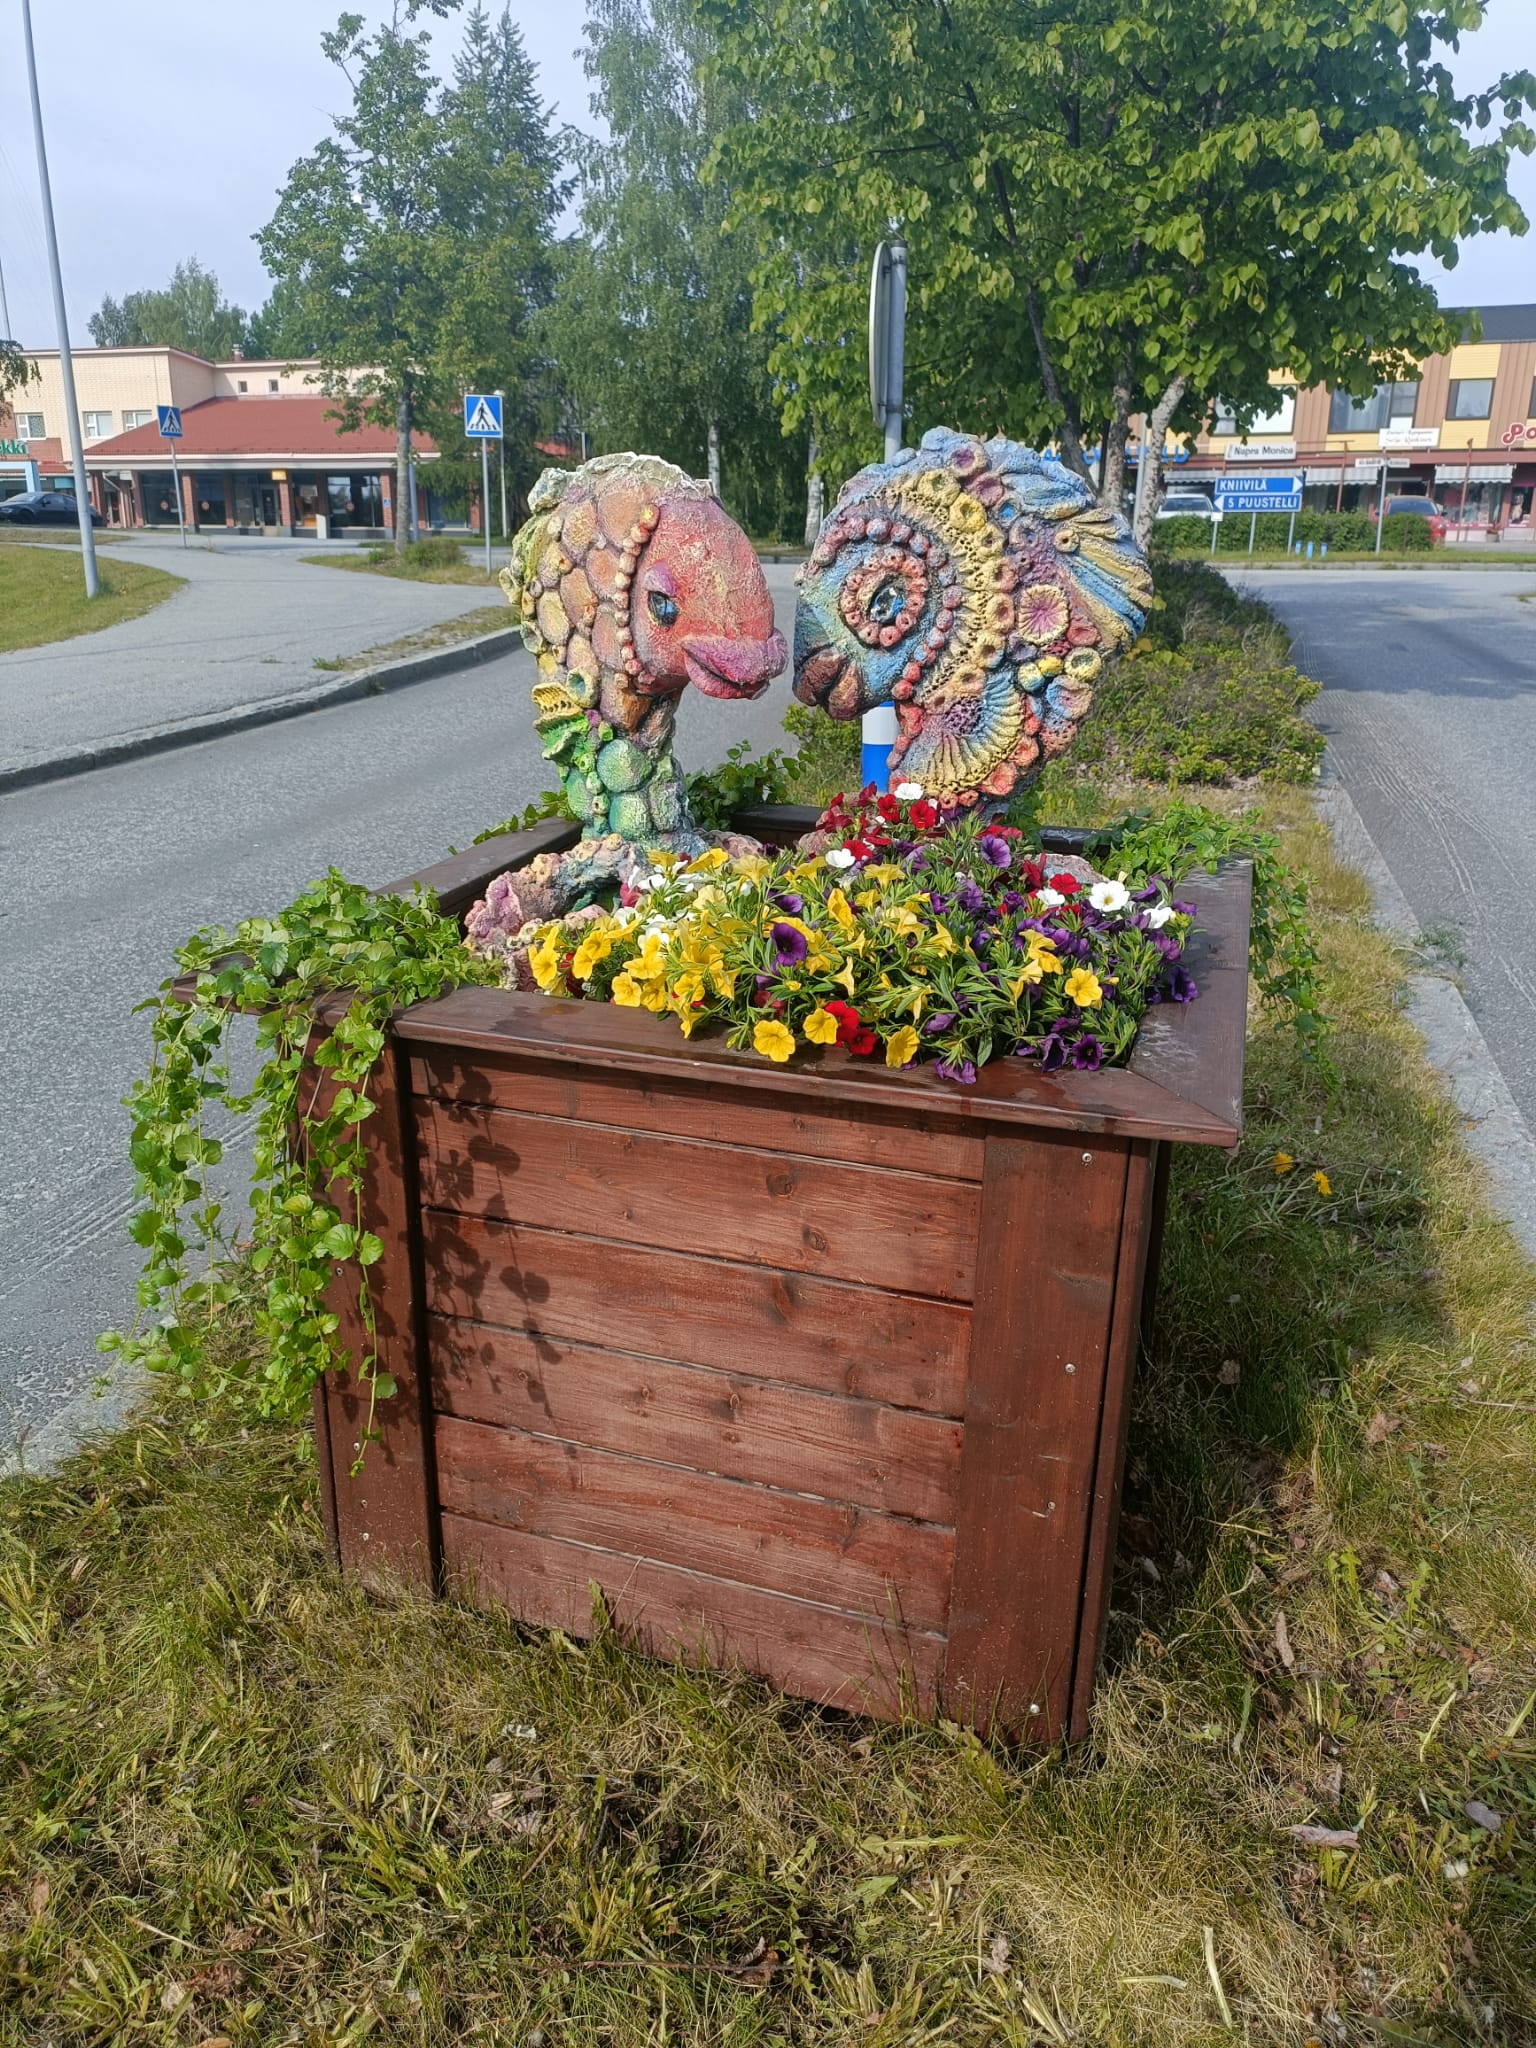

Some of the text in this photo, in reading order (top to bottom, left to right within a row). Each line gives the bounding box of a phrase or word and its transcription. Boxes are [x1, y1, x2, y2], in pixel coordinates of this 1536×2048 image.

[0, 439, 26, 454] kki
[1234, 445, 1294, 457] Napra Monica
[1220, 479, 1267, 490] KNIIVILÄ
[1239, 496, 1297, 508] PUUSTELLI
